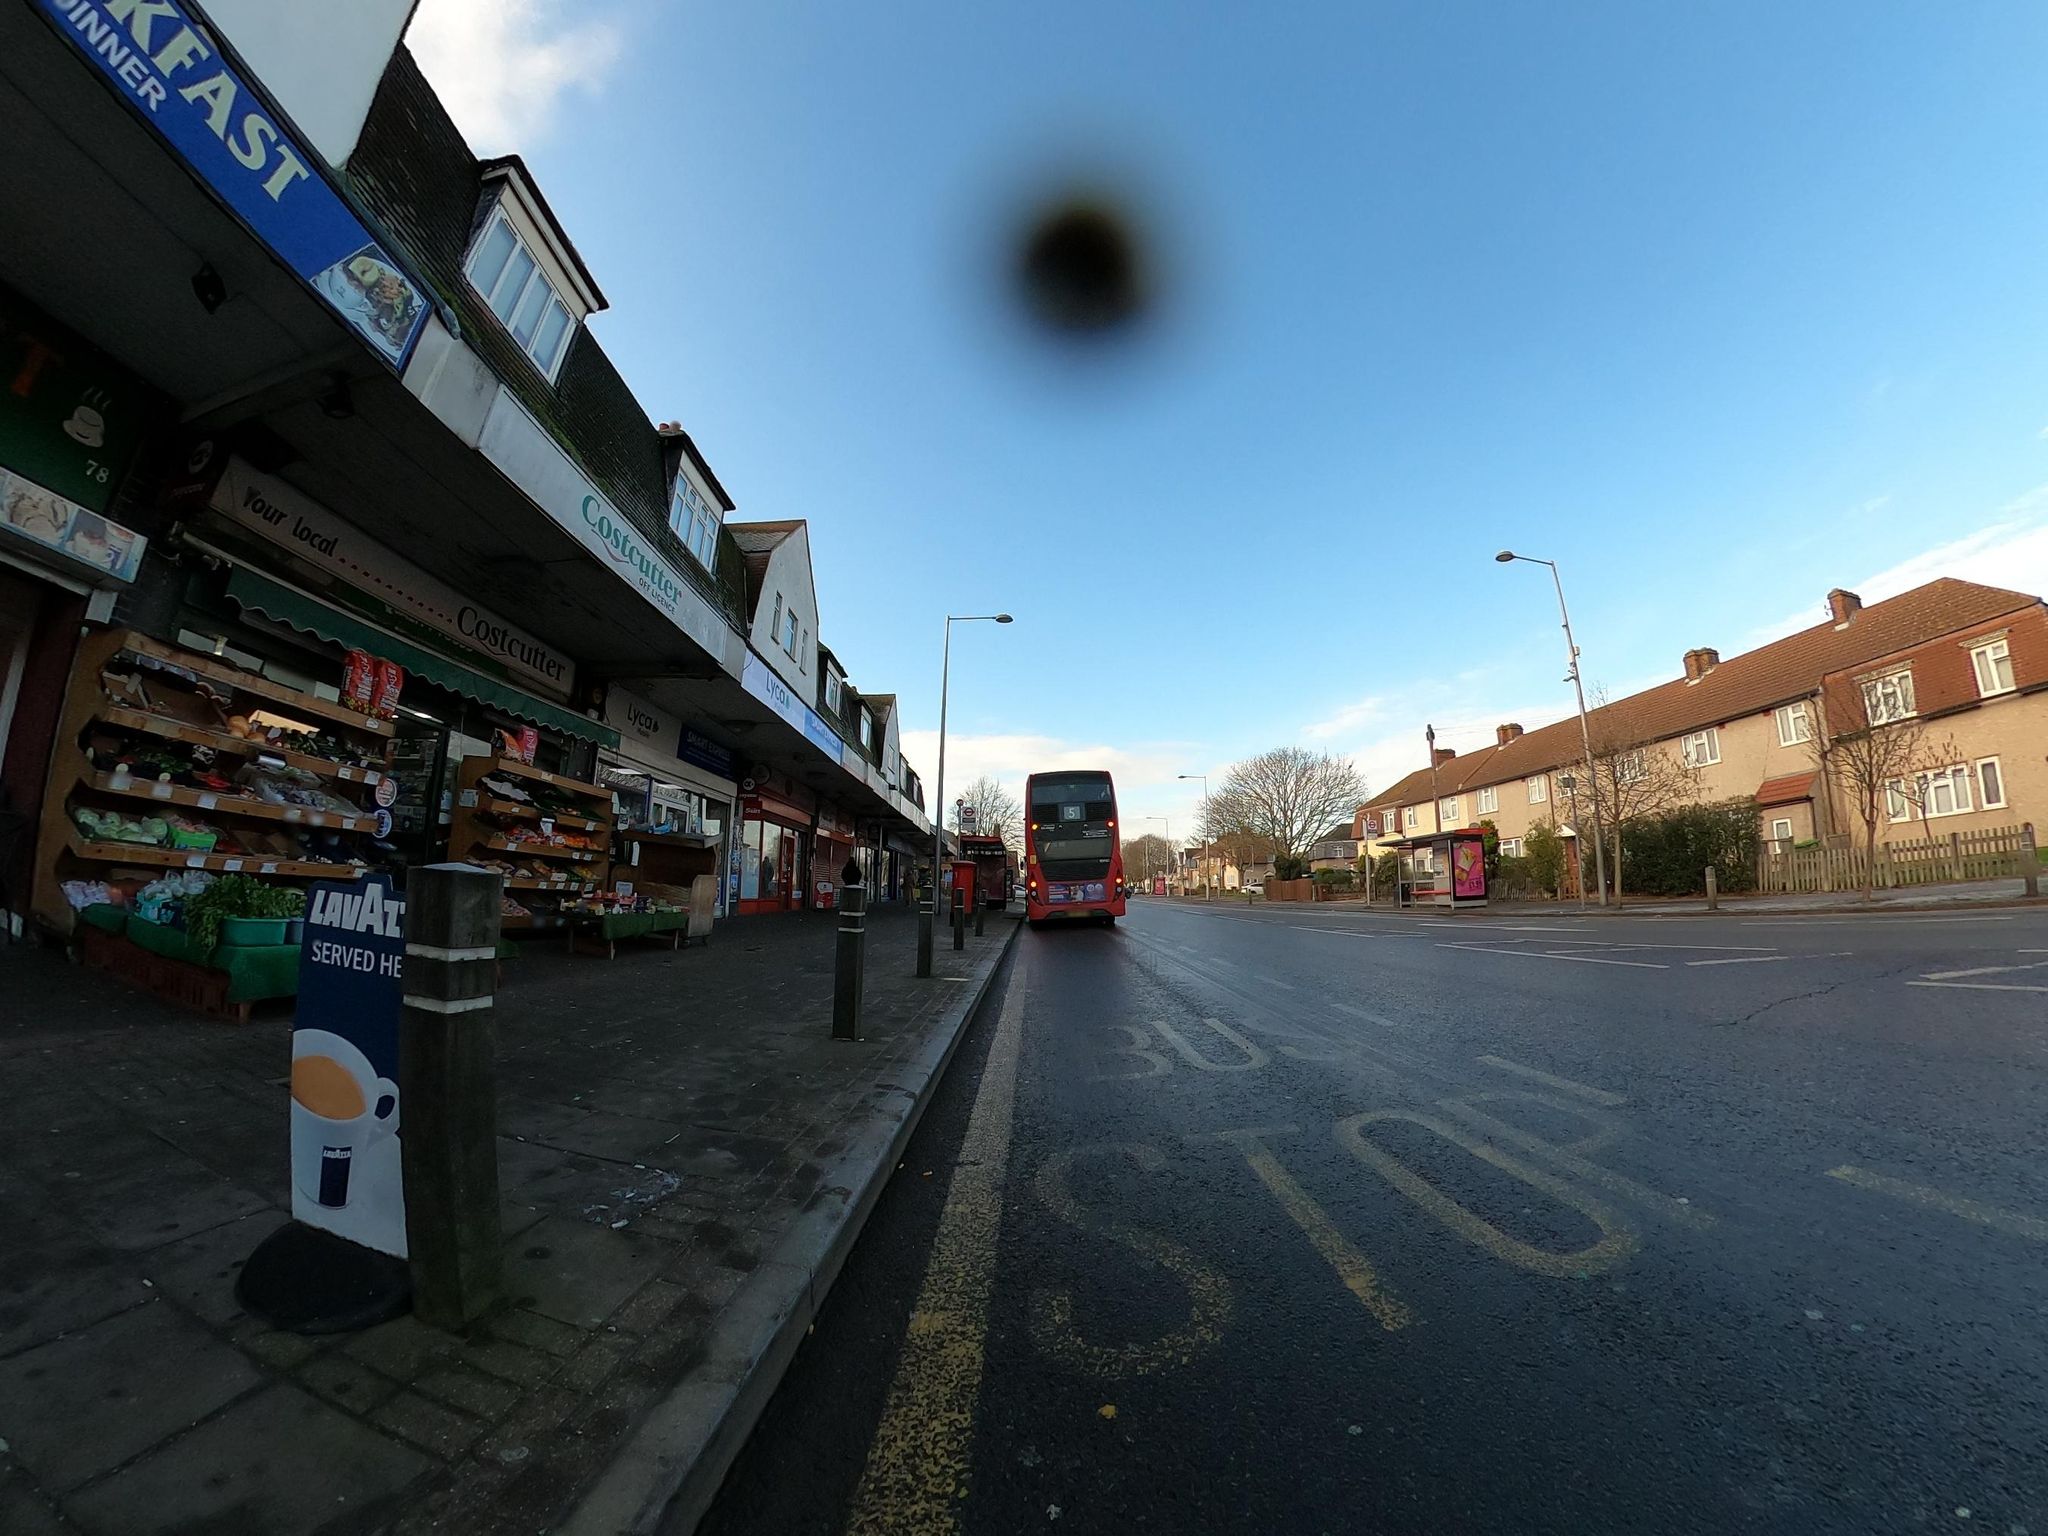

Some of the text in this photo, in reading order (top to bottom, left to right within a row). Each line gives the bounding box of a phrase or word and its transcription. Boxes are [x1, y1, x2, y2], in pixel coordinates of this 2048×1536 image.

[84, 458, 111, 485] 78
[581, 494, 680, 606] Costcutter
[241, 485, 289, 528] Your
[293, 515, 339, 559] local
[456, 604, 568, 683] Costcutter
[638, 577, 677, 616] OFF LICENCE
[765, 671, 786, 704] Lyca
[627, 703, 652, 731] Lyca
[311, 938, 376, 973] SERVED
